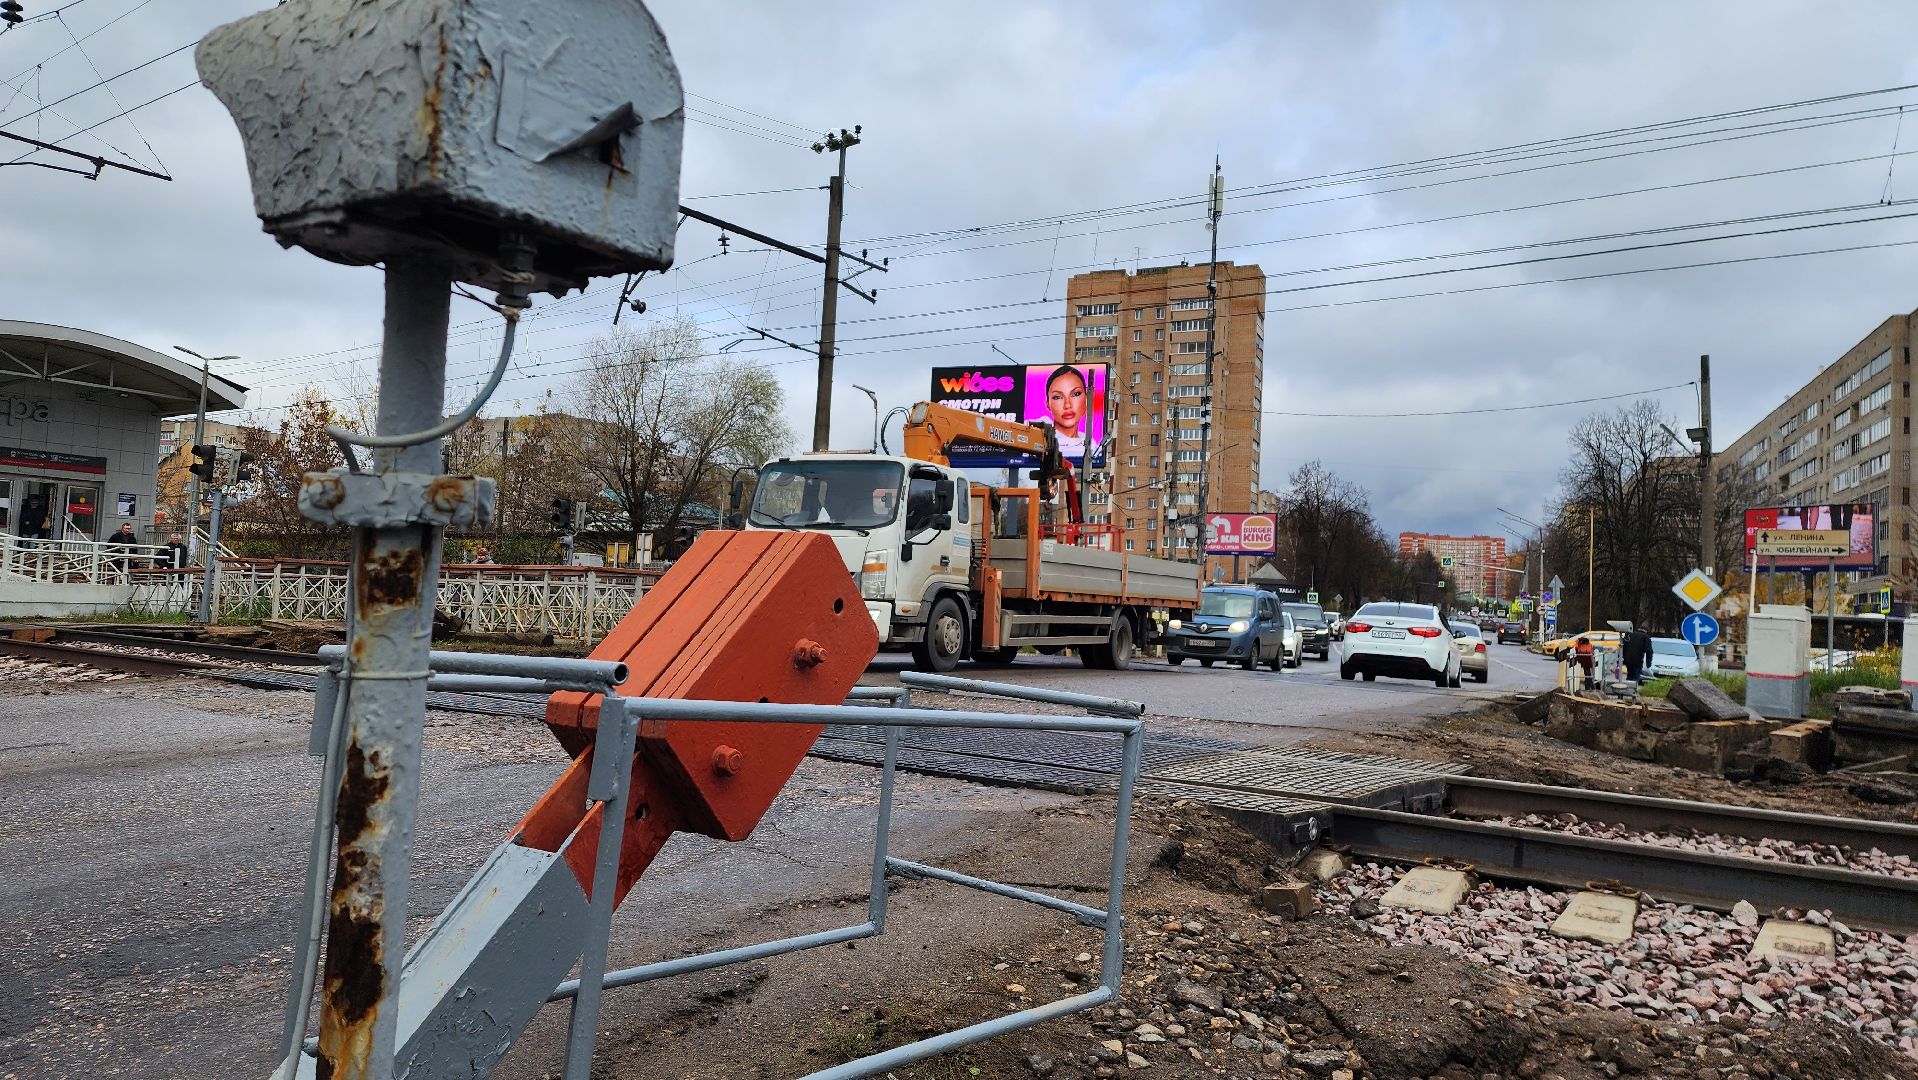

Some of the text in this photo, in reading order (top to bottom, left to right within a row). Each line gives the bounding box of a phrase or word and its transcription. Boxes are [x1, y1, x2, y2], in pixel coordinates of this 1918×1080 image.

[989, 426, 1013, 443] HANGIL
[1243, 533, 1272, 542] KING
[1776, 546, 1829, 554] ЮБИЛЕЙНАЯ
